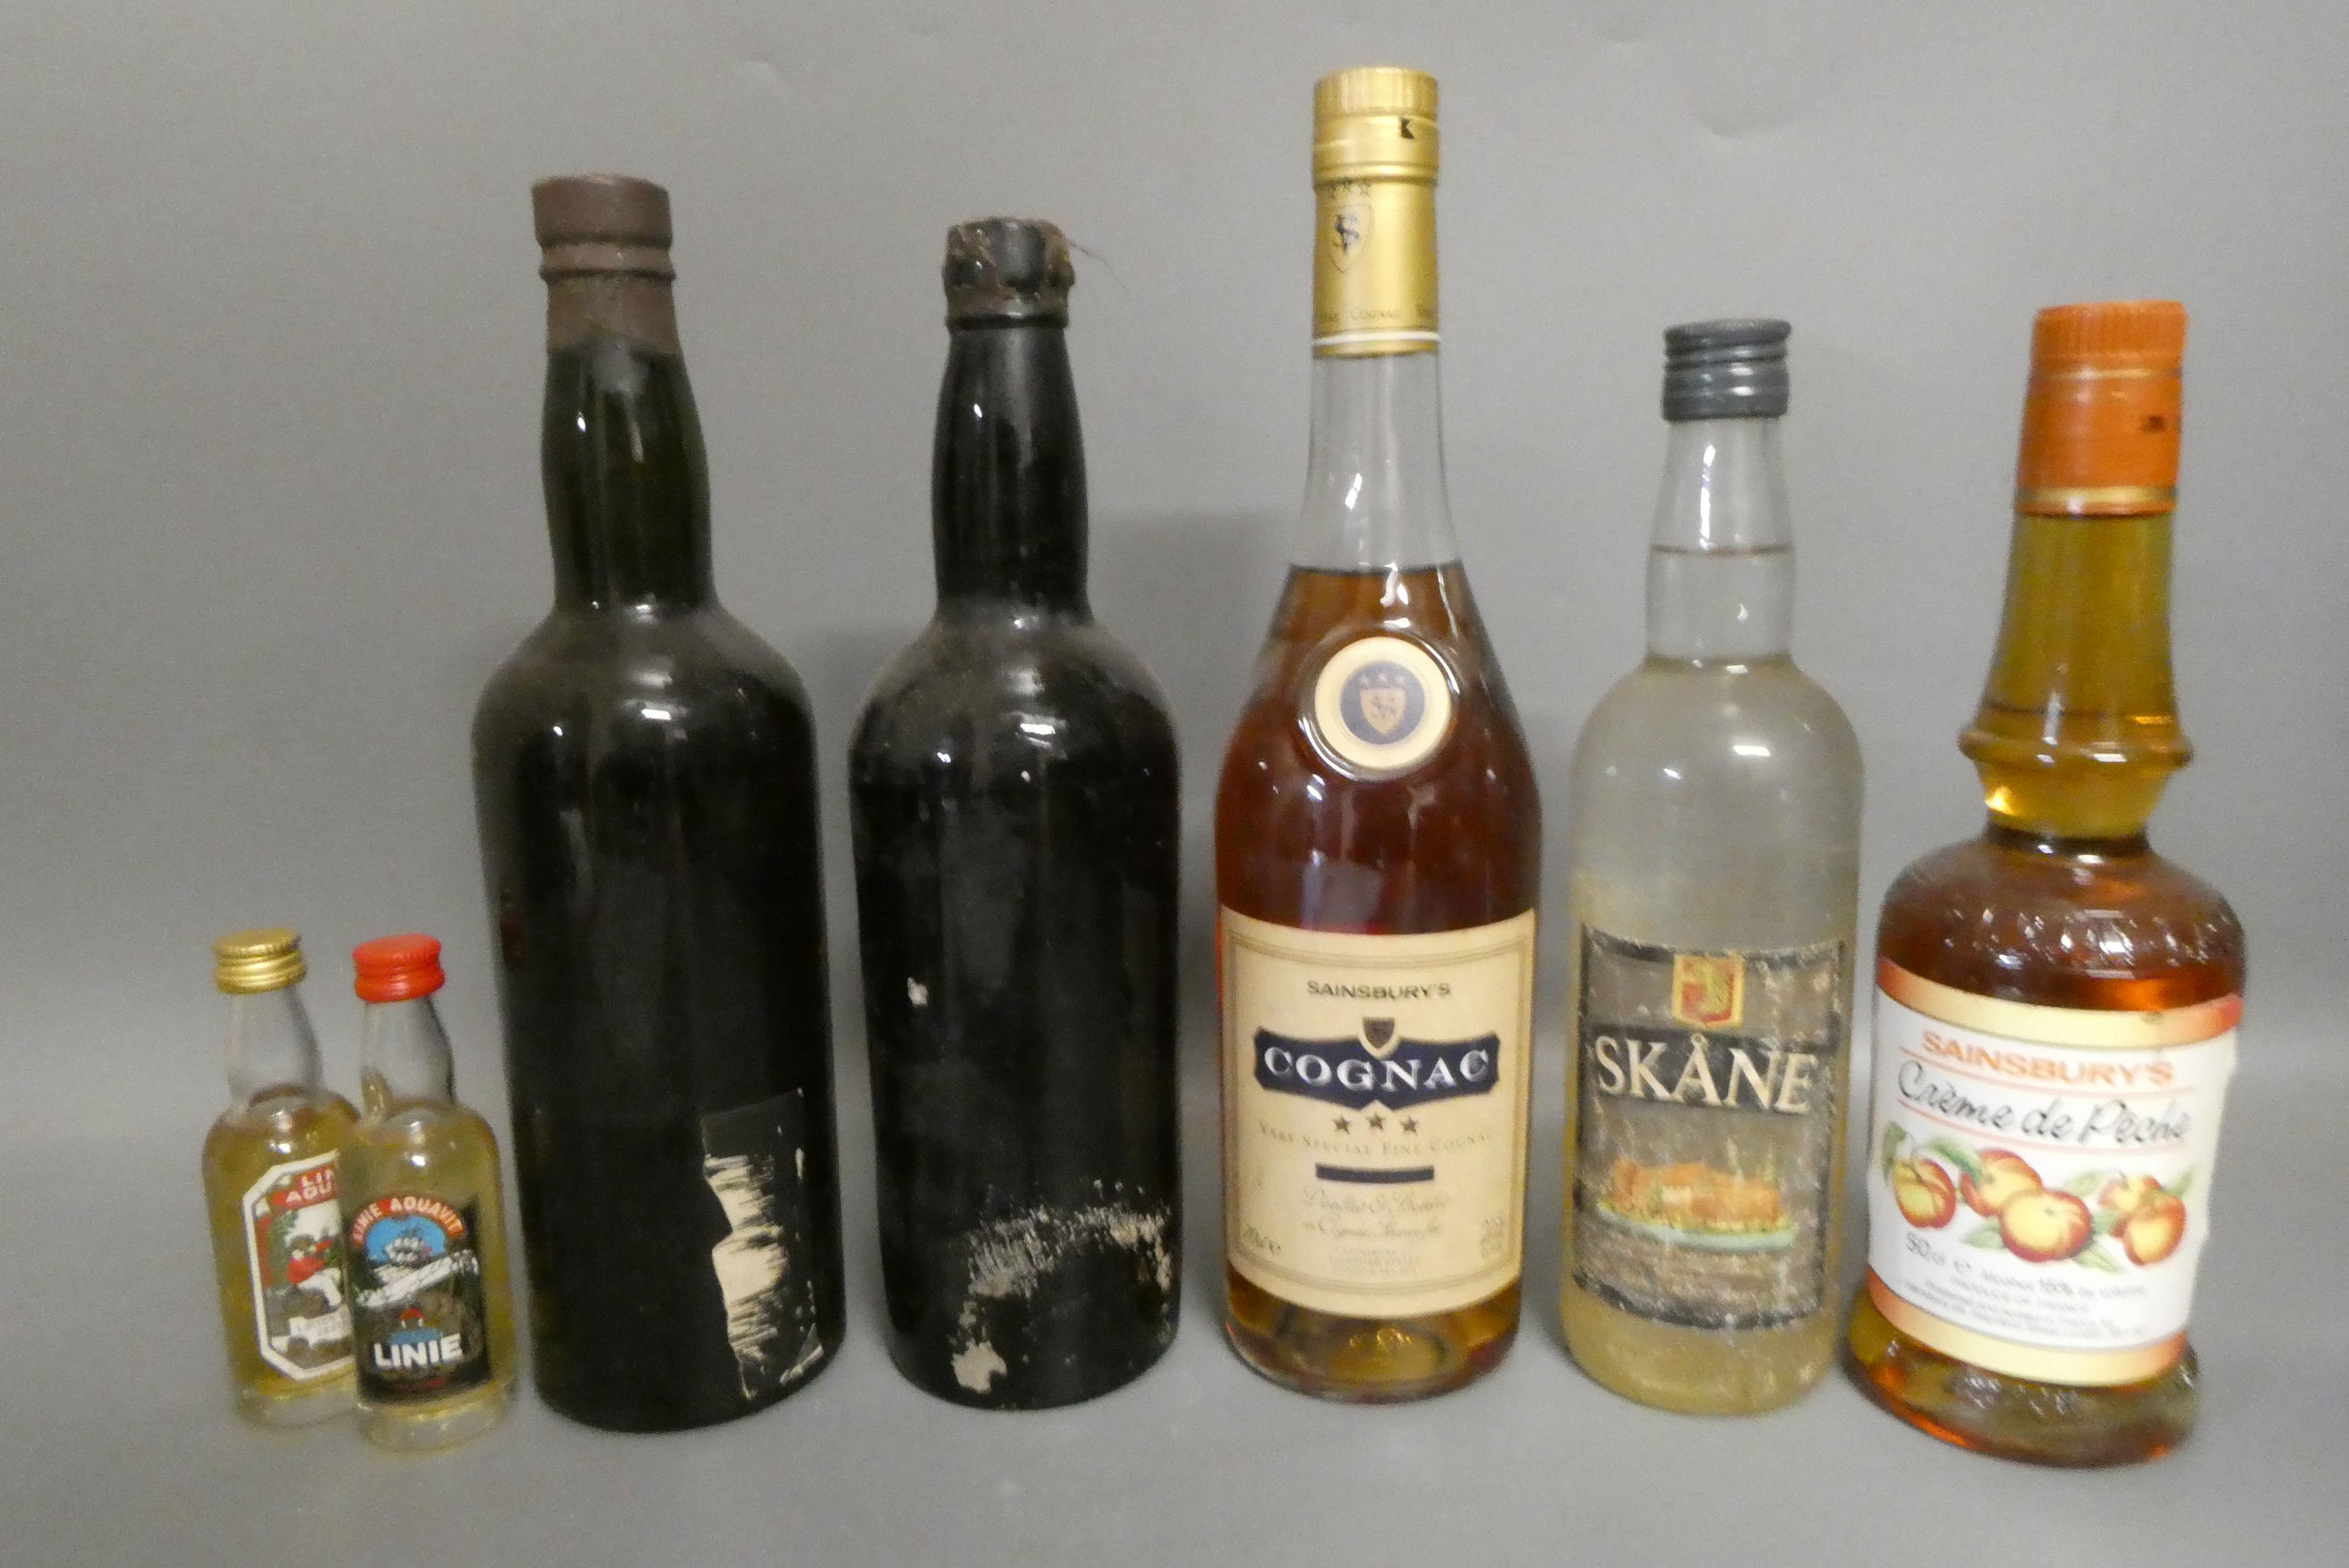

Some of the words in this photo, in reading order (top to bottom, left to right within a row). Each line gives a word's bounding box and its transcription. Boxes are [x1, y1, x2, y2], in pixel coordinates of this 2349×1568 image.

[1306, 979, 1451, 1000] SAINSBURY'S
[1263, 1045, 1490, 1092] COGNAC
[1593, 1033, 1819, 1115] SKÅNE
[1922, 1028, 2174, 1087] SAINSBURY'S
[2020, 1097, 2074, 1139] de
[372, 1332, 465, 1368] LINIE
